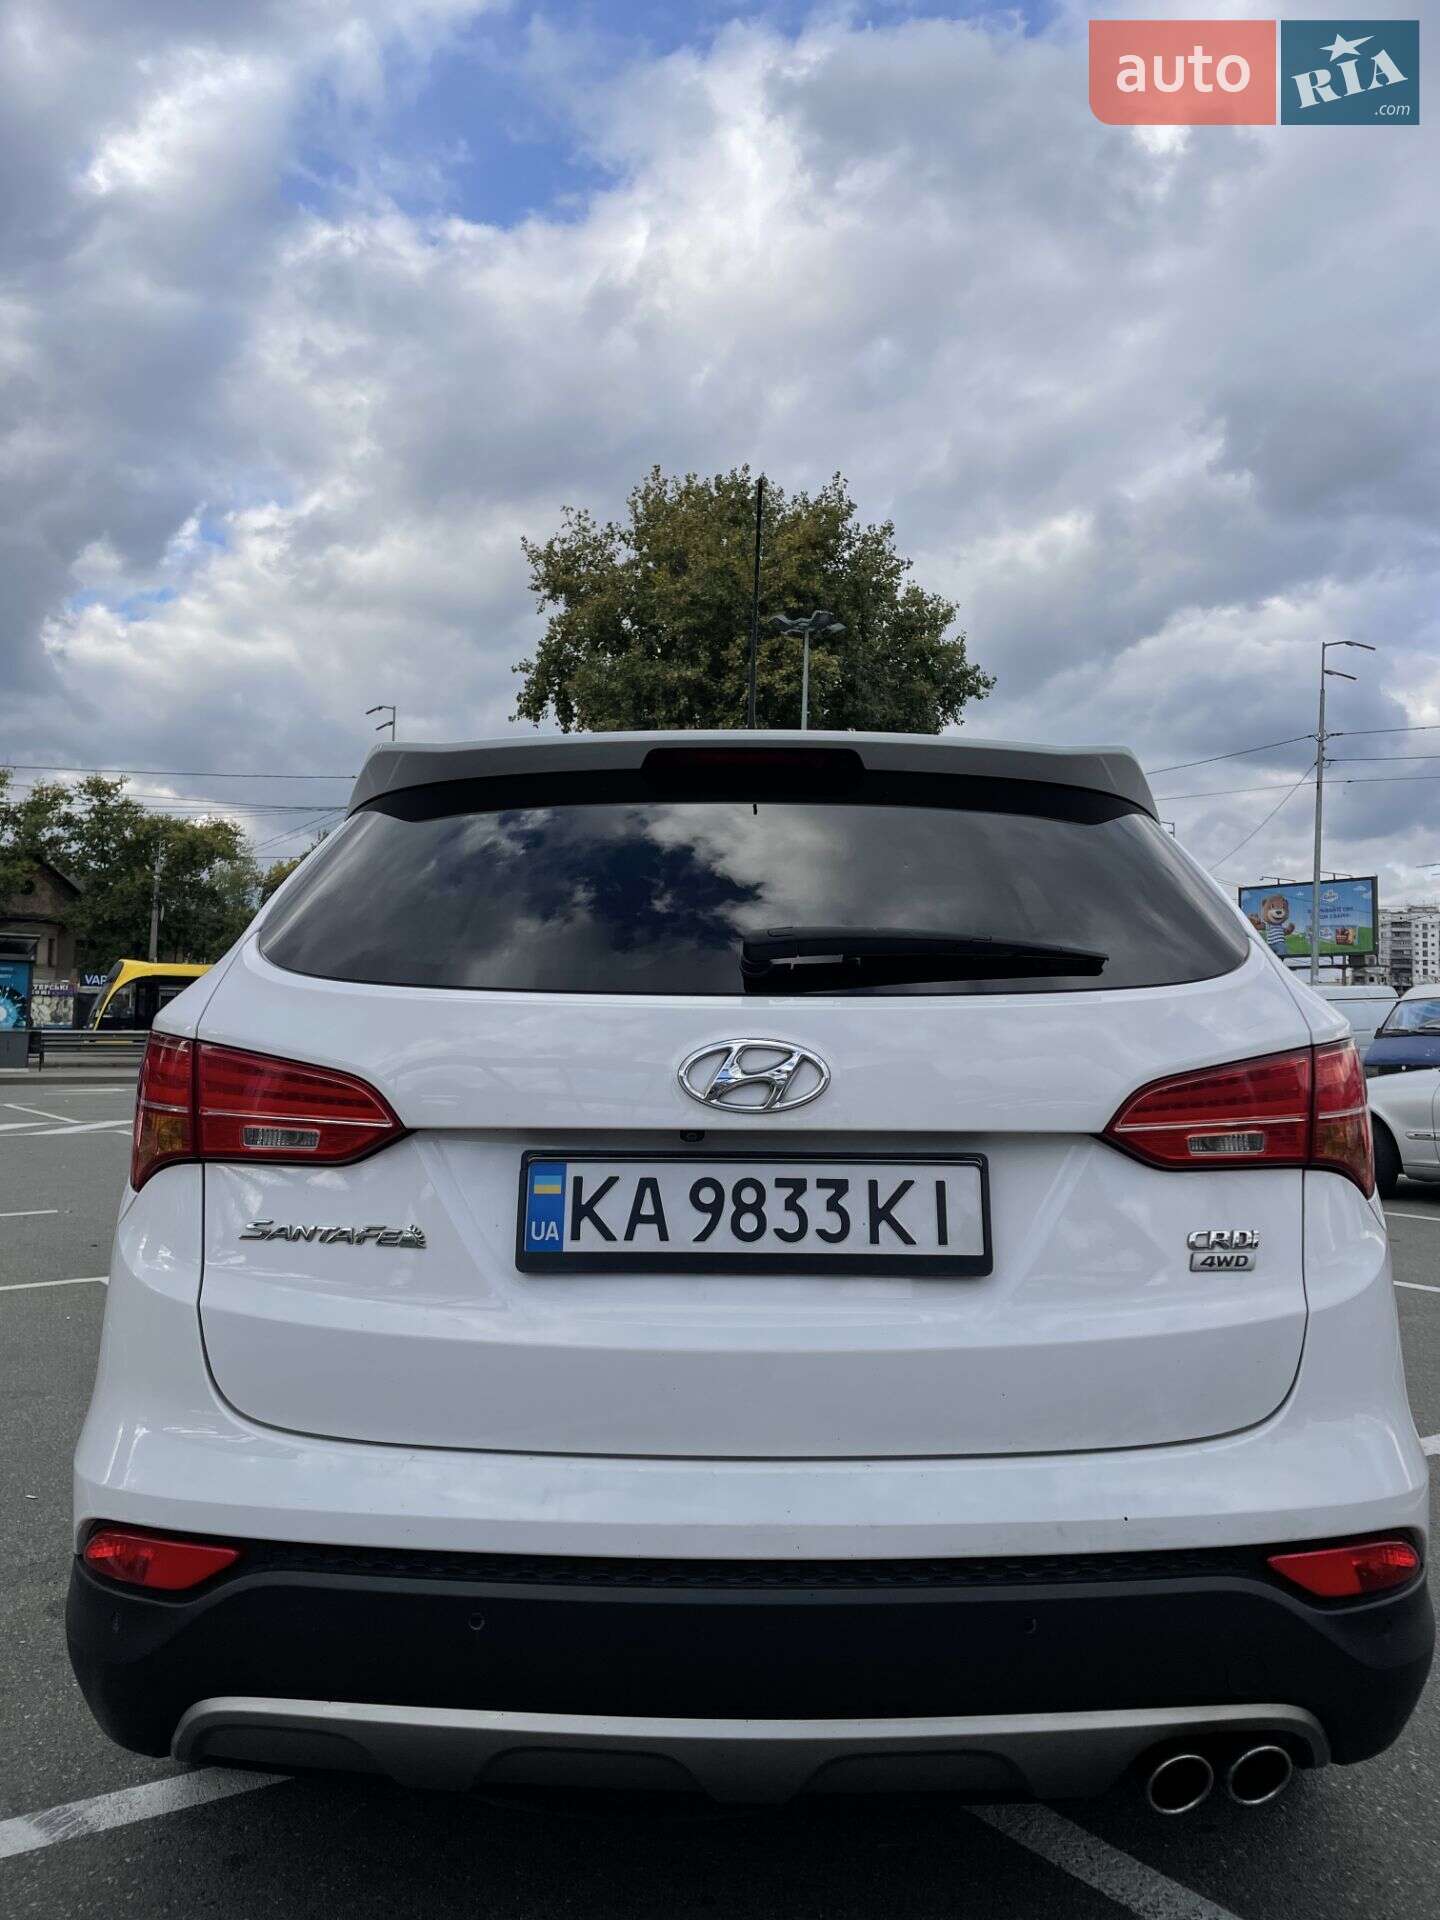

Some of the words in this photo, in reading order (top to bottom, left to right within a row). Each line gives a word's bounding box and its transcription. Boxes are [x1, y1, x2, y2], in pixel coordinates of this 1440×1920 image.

[570, 1175, 670, 1242] KA
[689, 1176, 851, 1243] 9833
[868, 1179, 949, 1246] KI
[531, 1222, 560, 1241] UA
[1200, 1255, 1249, 1268] 4WD
